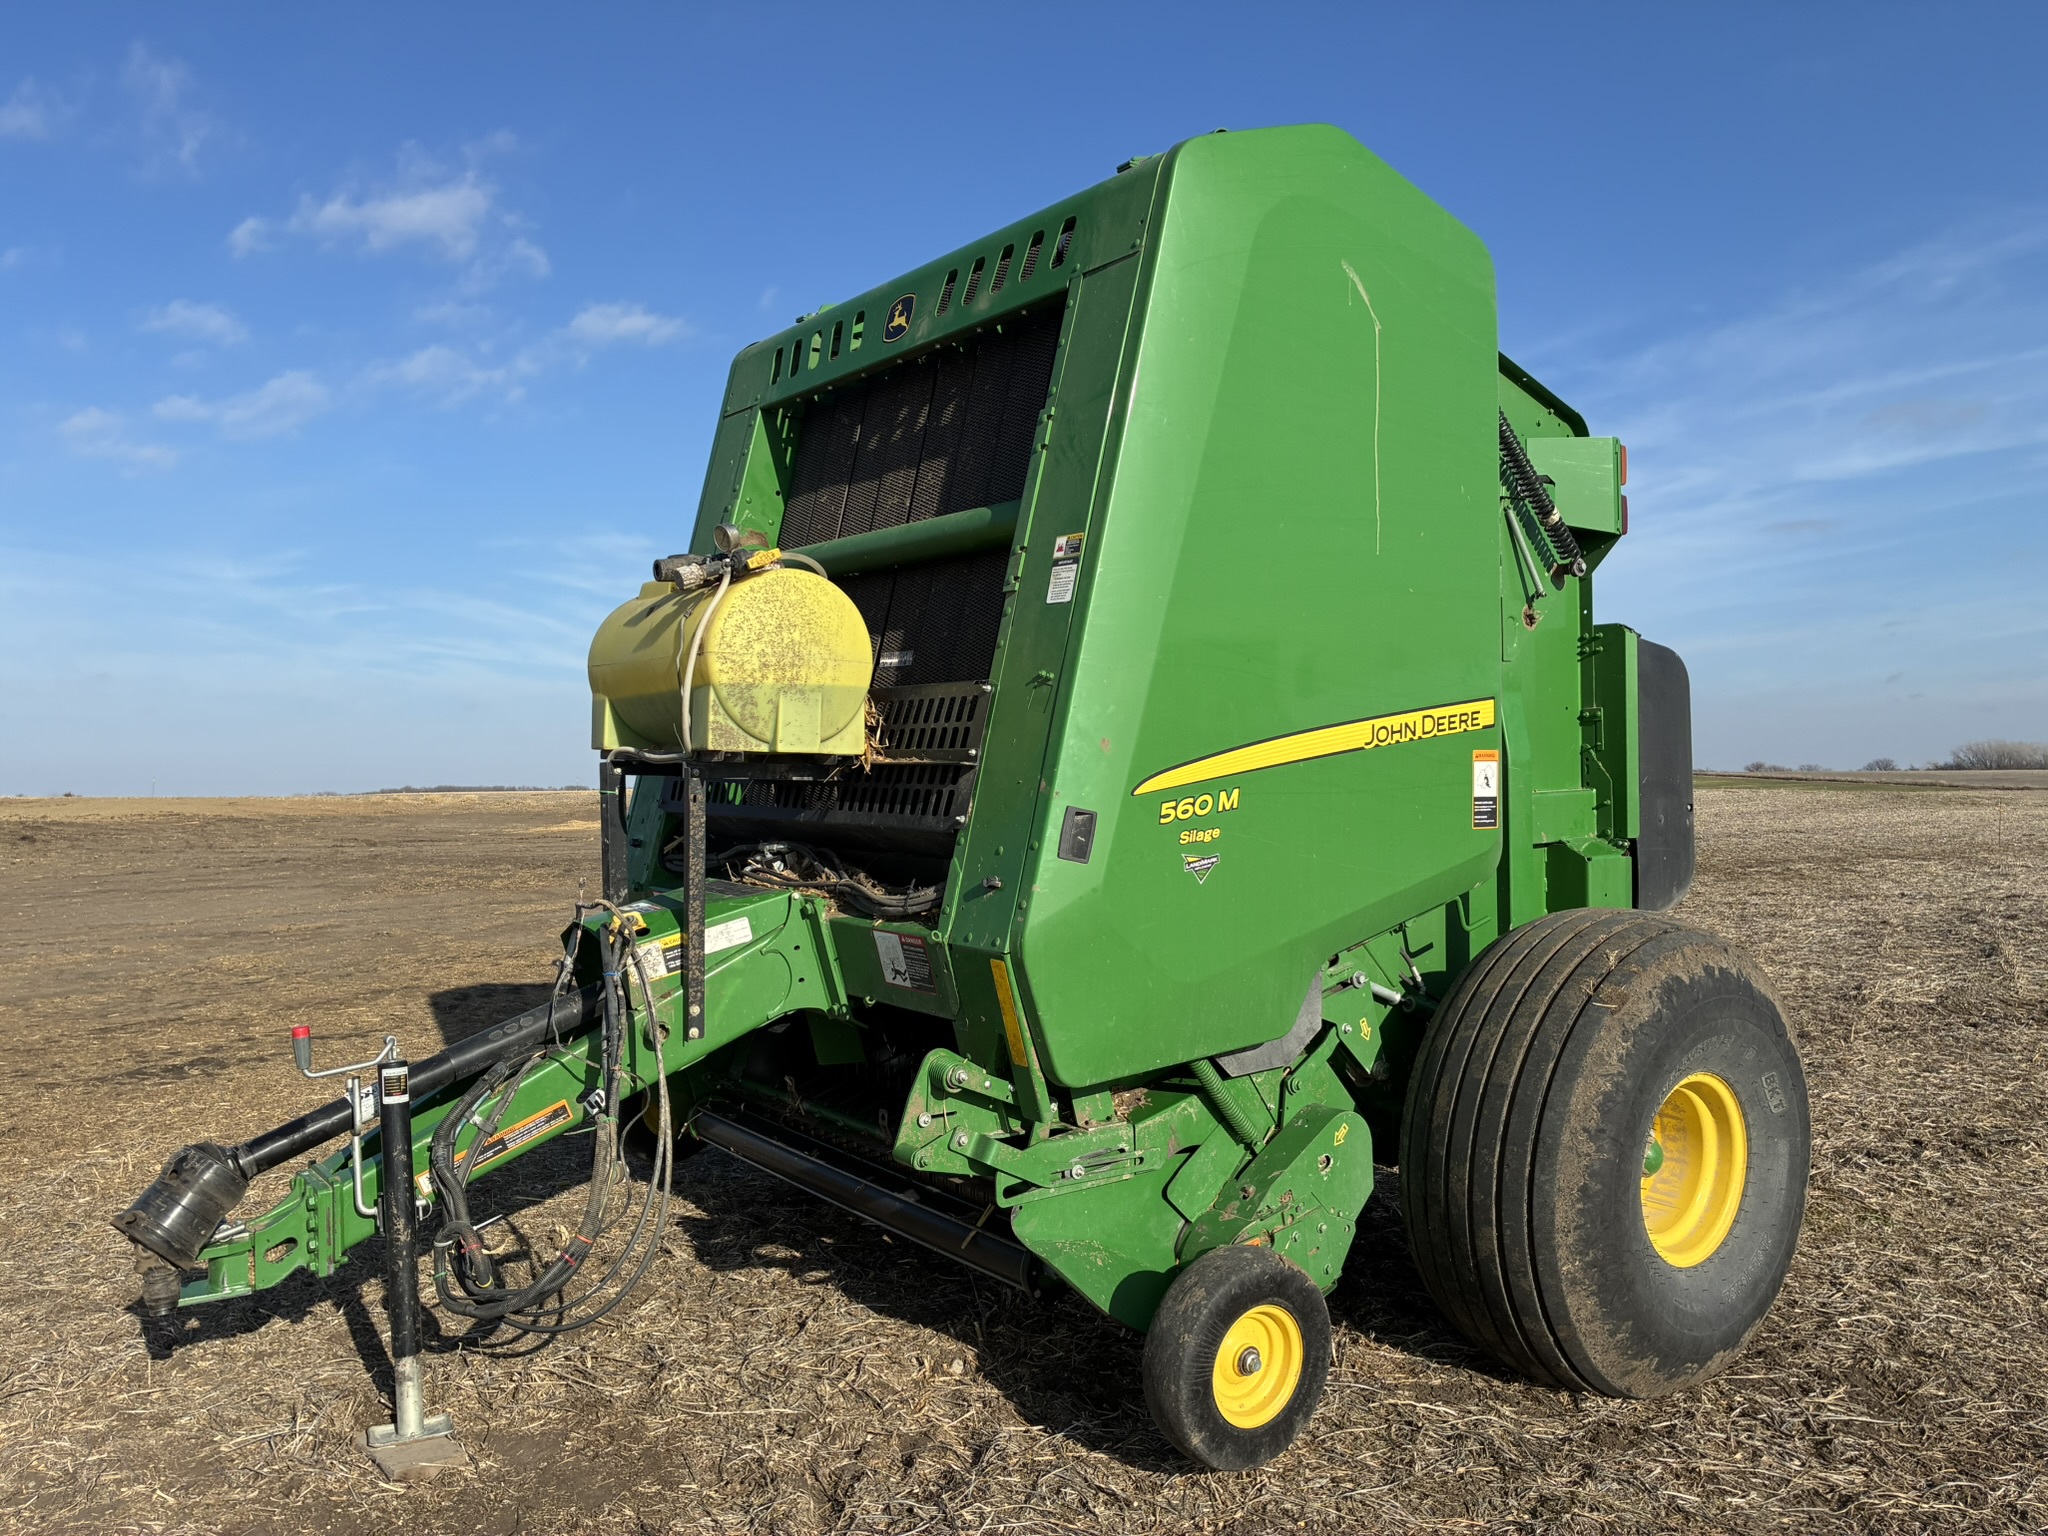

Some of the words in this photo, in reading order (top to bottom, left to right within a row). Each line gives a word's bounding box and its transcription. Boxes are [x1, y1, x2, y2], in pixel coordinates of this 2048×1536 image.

[1364, 720, 1417, 746] JOHN
[1421, 710, 1481, 735] DEERE
[1159, 793, 1214, 824] 560
[1217, 787, 1240, 813] M
[1179, 827, 1221, 845] Silage
[1763, 1072, 1787, 1111] BKT
